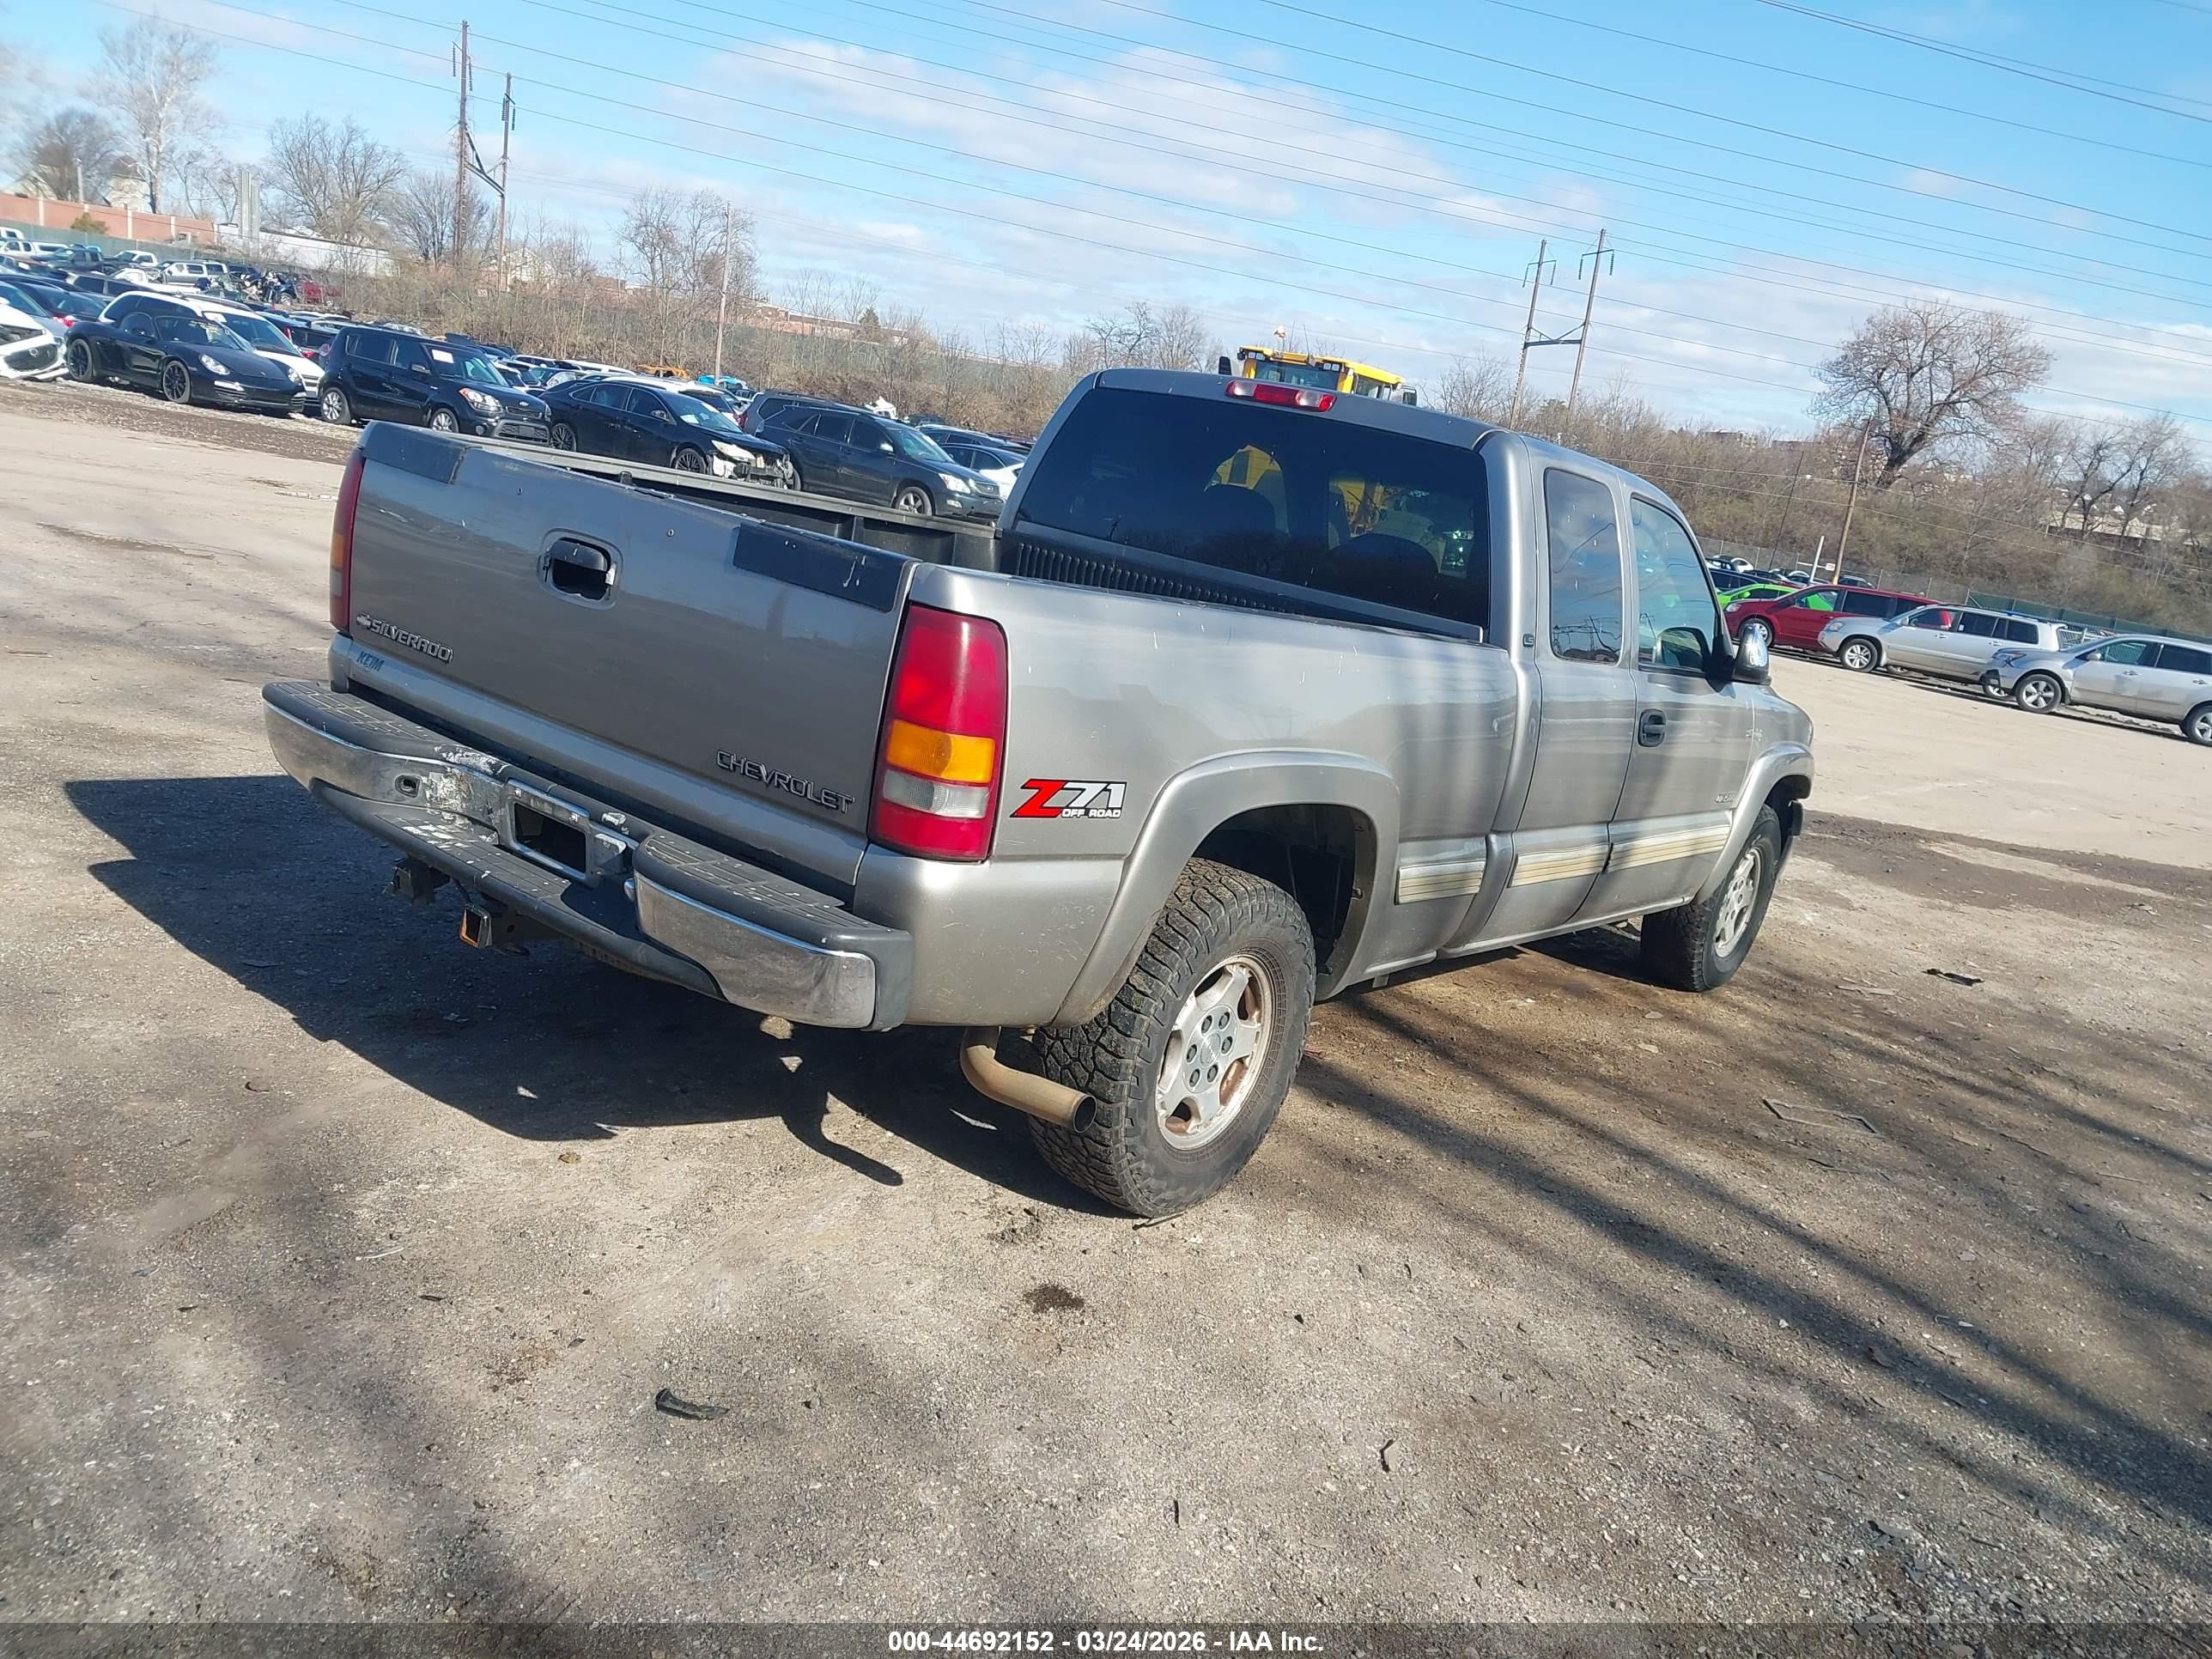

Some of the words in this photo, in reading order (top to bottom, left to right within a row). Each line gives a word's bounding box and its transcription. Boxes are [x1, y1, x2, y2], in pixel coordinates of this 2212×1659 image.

[370, 618, 453, 663] SILVERADO
[716, 750, 856, 813] CHEVROLET
[1010, 778, 1127, 817] Z71
[1061, 808, 1085, 817] OFF
[1088, 808, 1121, 818] ROAD
